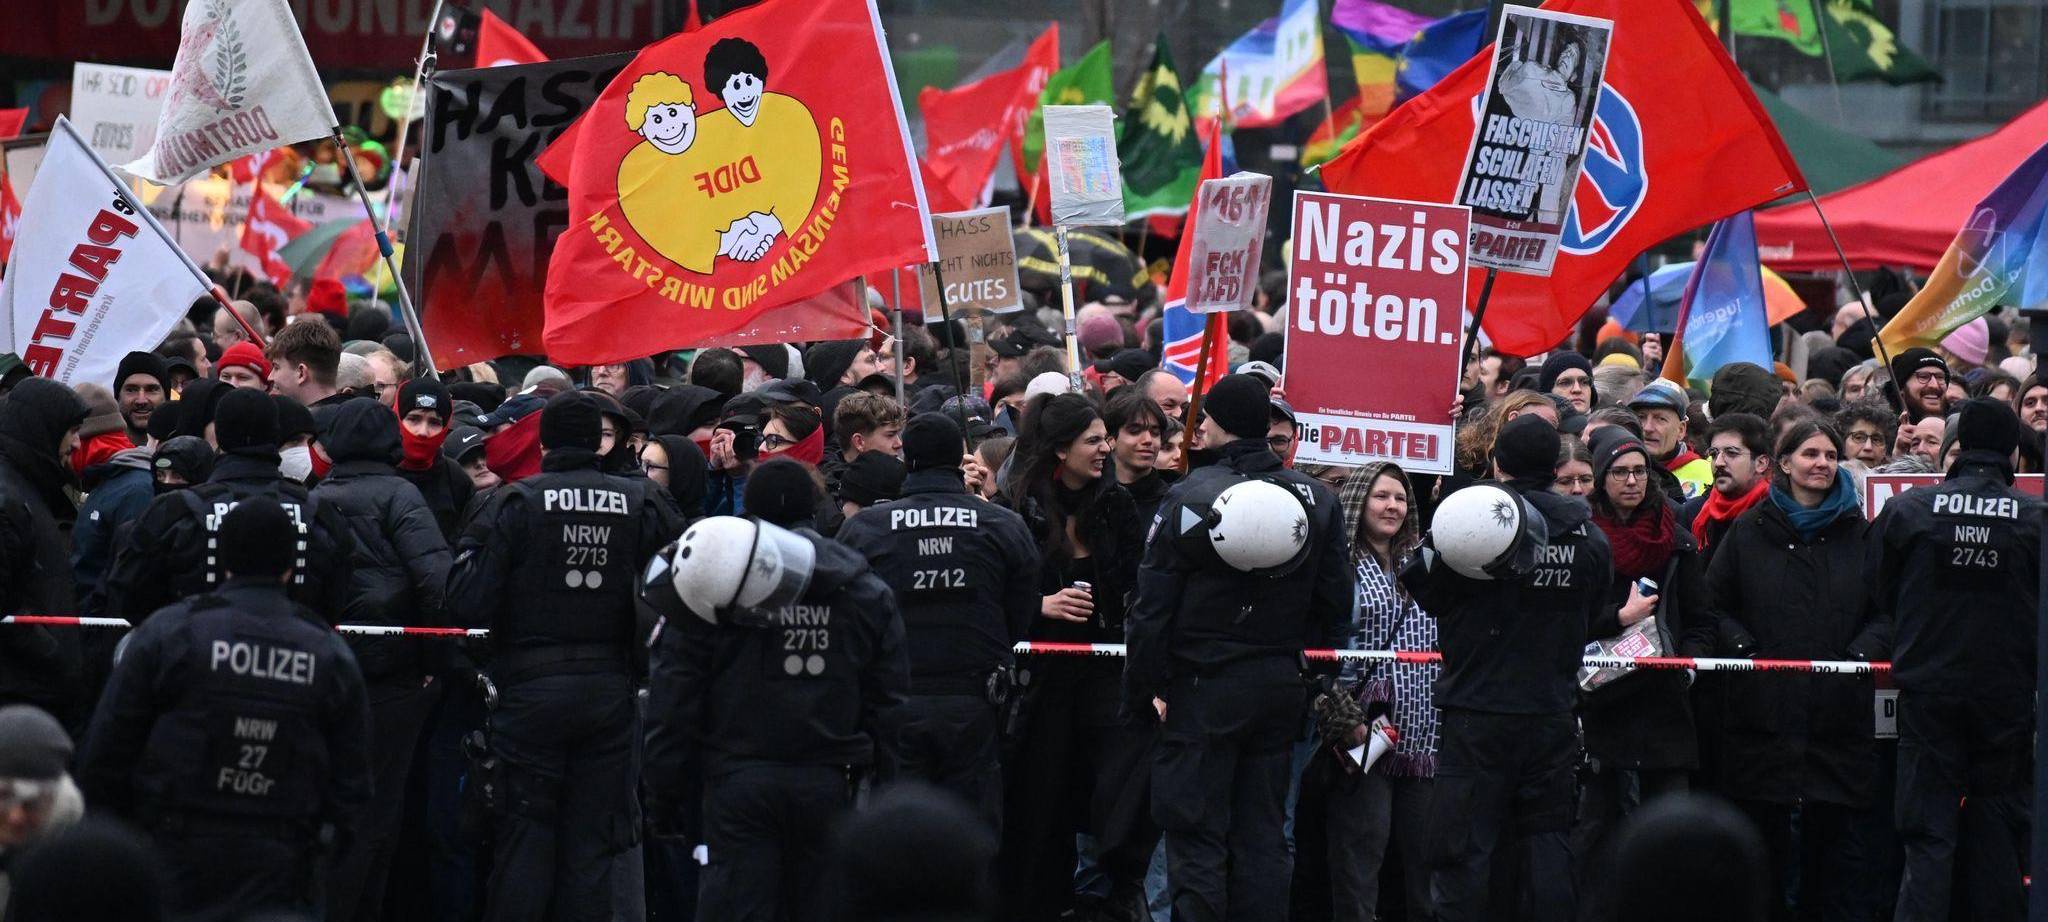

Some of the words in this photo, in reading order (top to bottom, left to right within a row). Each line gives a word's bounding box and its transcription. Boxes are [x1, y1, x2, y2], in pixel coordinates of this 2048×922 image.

[1484, 114, 1584, 155] FASCHISTEN
[1476, 146, 1562, 185] SCHLAFEN
[1211, 184, 1259, 221] 161
[1466, 177, 1536, 214] LASSEN
[941, 217, 991, 239] HASS
[1299, 200, 1459, 275] Nazis
[1473, 231, 1546, 263] PARTEI
[921, 256, 964, 276] MCHT
[971, 251, 1013, 269] NICHTS
[1207, 250, 1245, 276] FCK
[945, 279, 1007, 305] GUTES
[1205, 276, 1240, 301] AFD
[1296, 272, 1453, 345] töten.
[1391, 413, 1416, 421] PARTEI
[1320, 425, 1438, 461] PARTEI
[544, 488, 628, 515] POLIZEI
[1933, 494, 2018, 519] POLIZEI
[891, 507, 977, 530] POLIZEI
[563, 524, 611, 545] NRW
[919, 537, 953, 556] NRW
[1955, 525, 1990, 544] NRW
[566, 546, 608, 566] 2713
[1533, 545, 1575, 564] NRW
[1952, 547, 1998, 568] 2743
[913, 569, 965, 589] 2712
[1533, 569, 1570, 587] 2712
[780, 606, 830, 626] NRW
[784, 629, 829, 650] 2713
[210, 640, 315, 685] POLIZEI
[234, 716, 278, 741] NRW
[238, 744, 268, 769] 27
